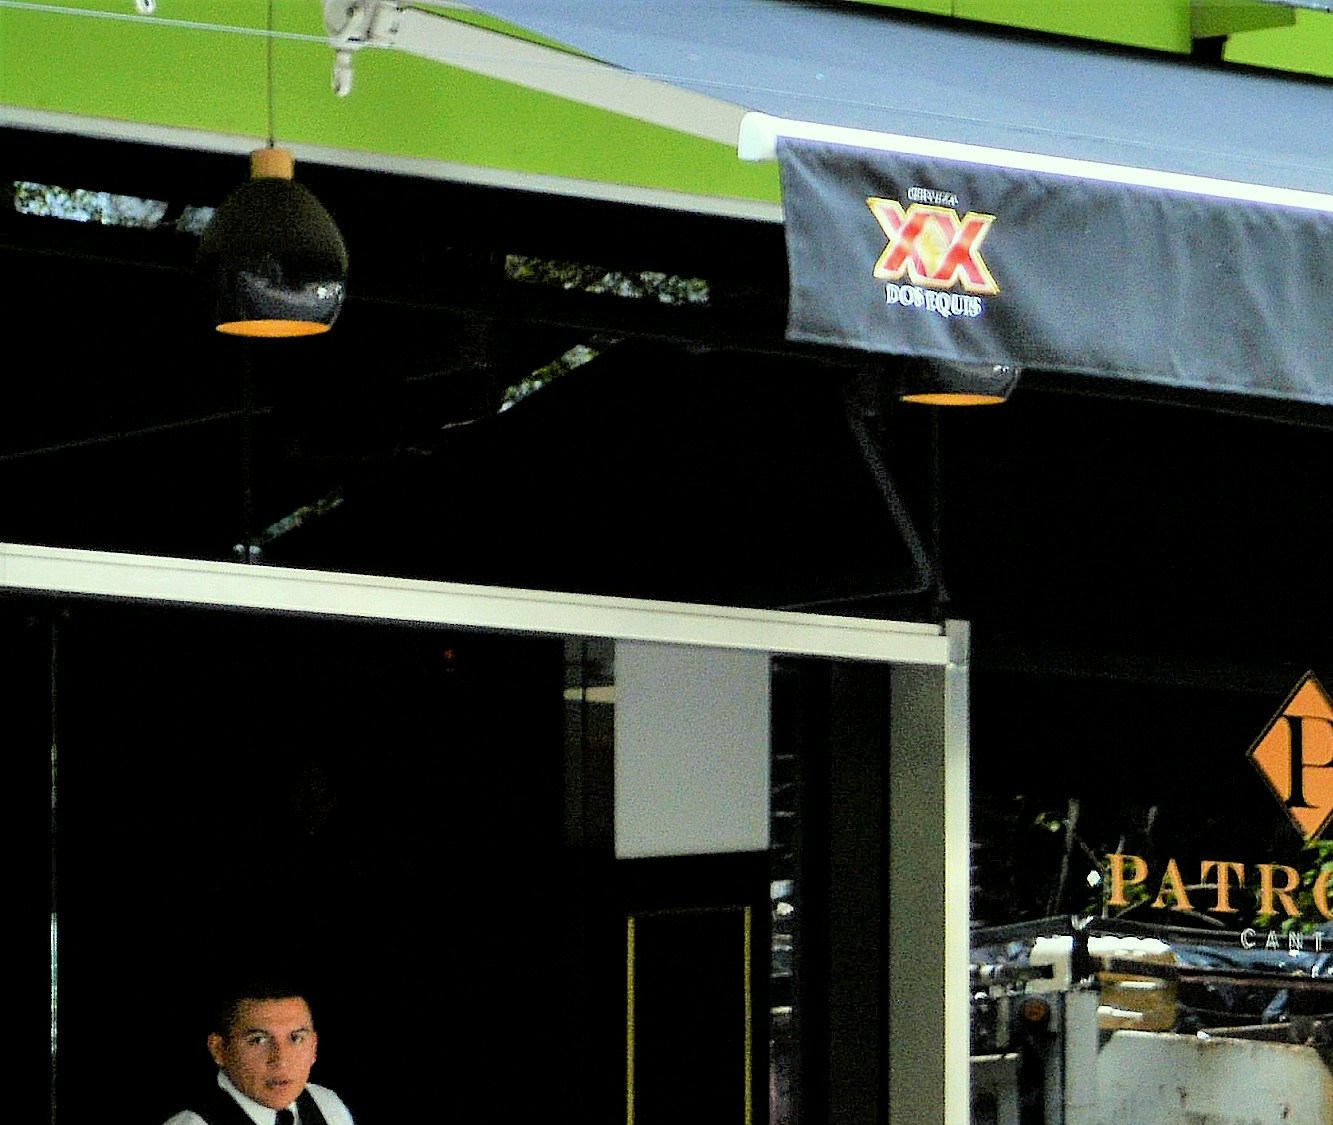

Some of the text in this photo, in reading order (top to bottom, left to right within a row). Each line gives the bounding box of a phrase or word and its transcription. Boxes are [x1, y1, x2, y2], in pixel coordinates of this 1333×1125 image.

[866, 196, 1001, 296] XX
[885, 283, 983, 318] DOS EQUIS
